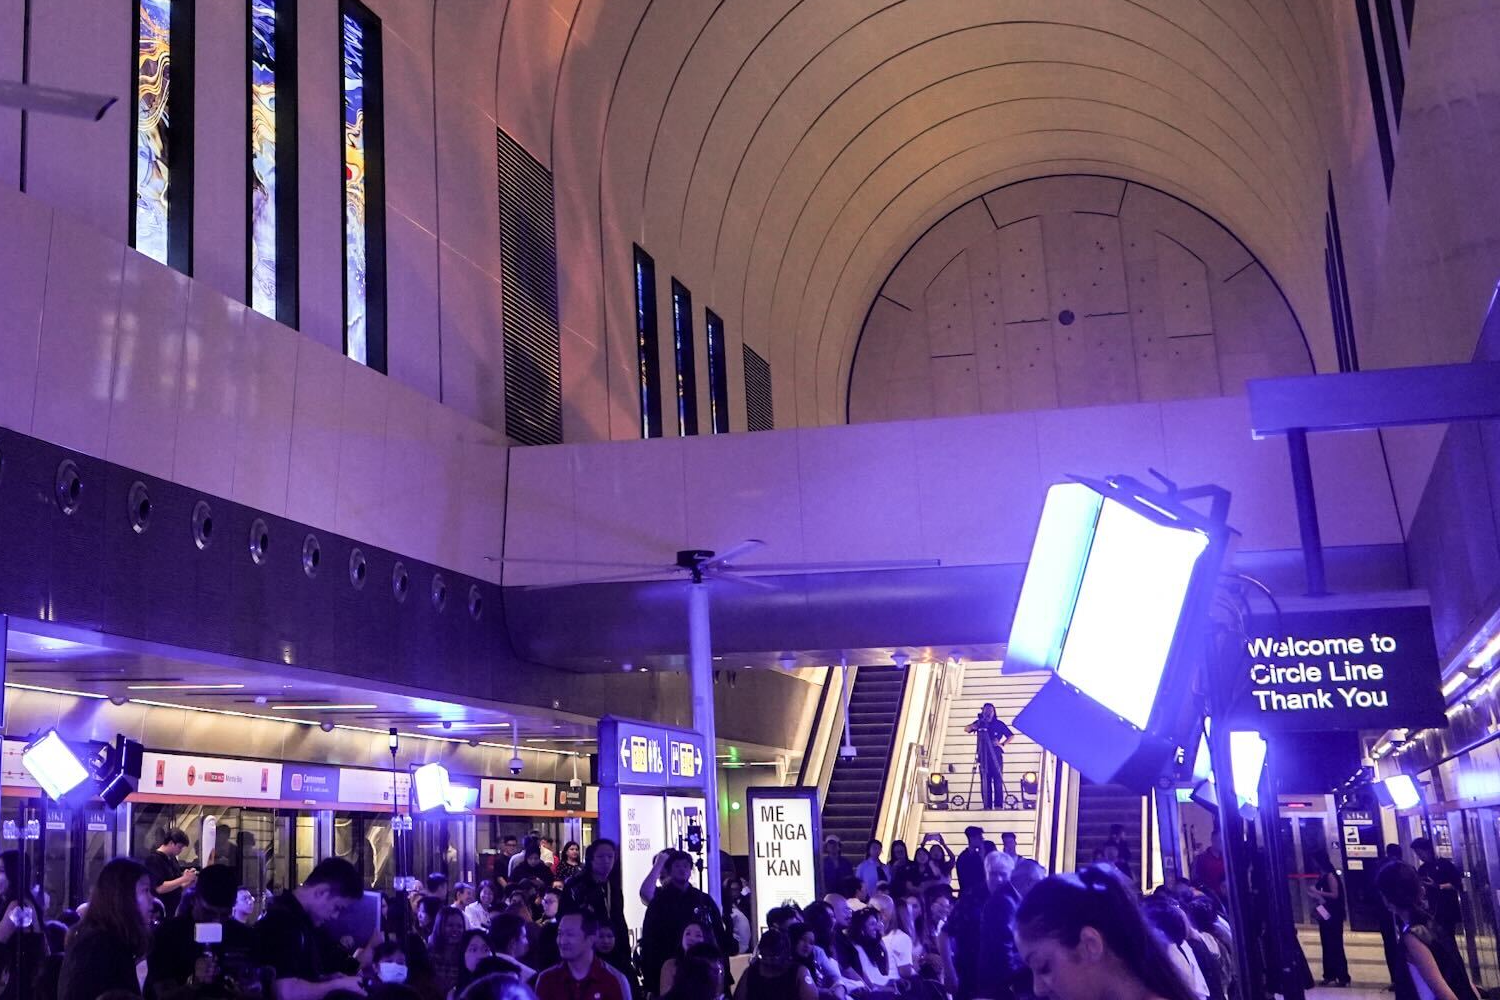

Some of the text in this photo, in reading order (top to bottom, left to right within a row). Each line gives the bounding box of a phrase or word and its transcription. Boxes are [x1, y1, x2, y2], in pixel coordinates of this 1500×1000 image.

[1248, 633, 1397, 658] Welcome to
[1250, 660, 1384, 685] Circle Line
[1252, 686, 1389, 710] Thank You
[761, 805, 785, 822] ME
[773, 824, 807, 841] NGA
[756, 842, 782, 858] LIH
[767, 859, 801, 876] KAN
